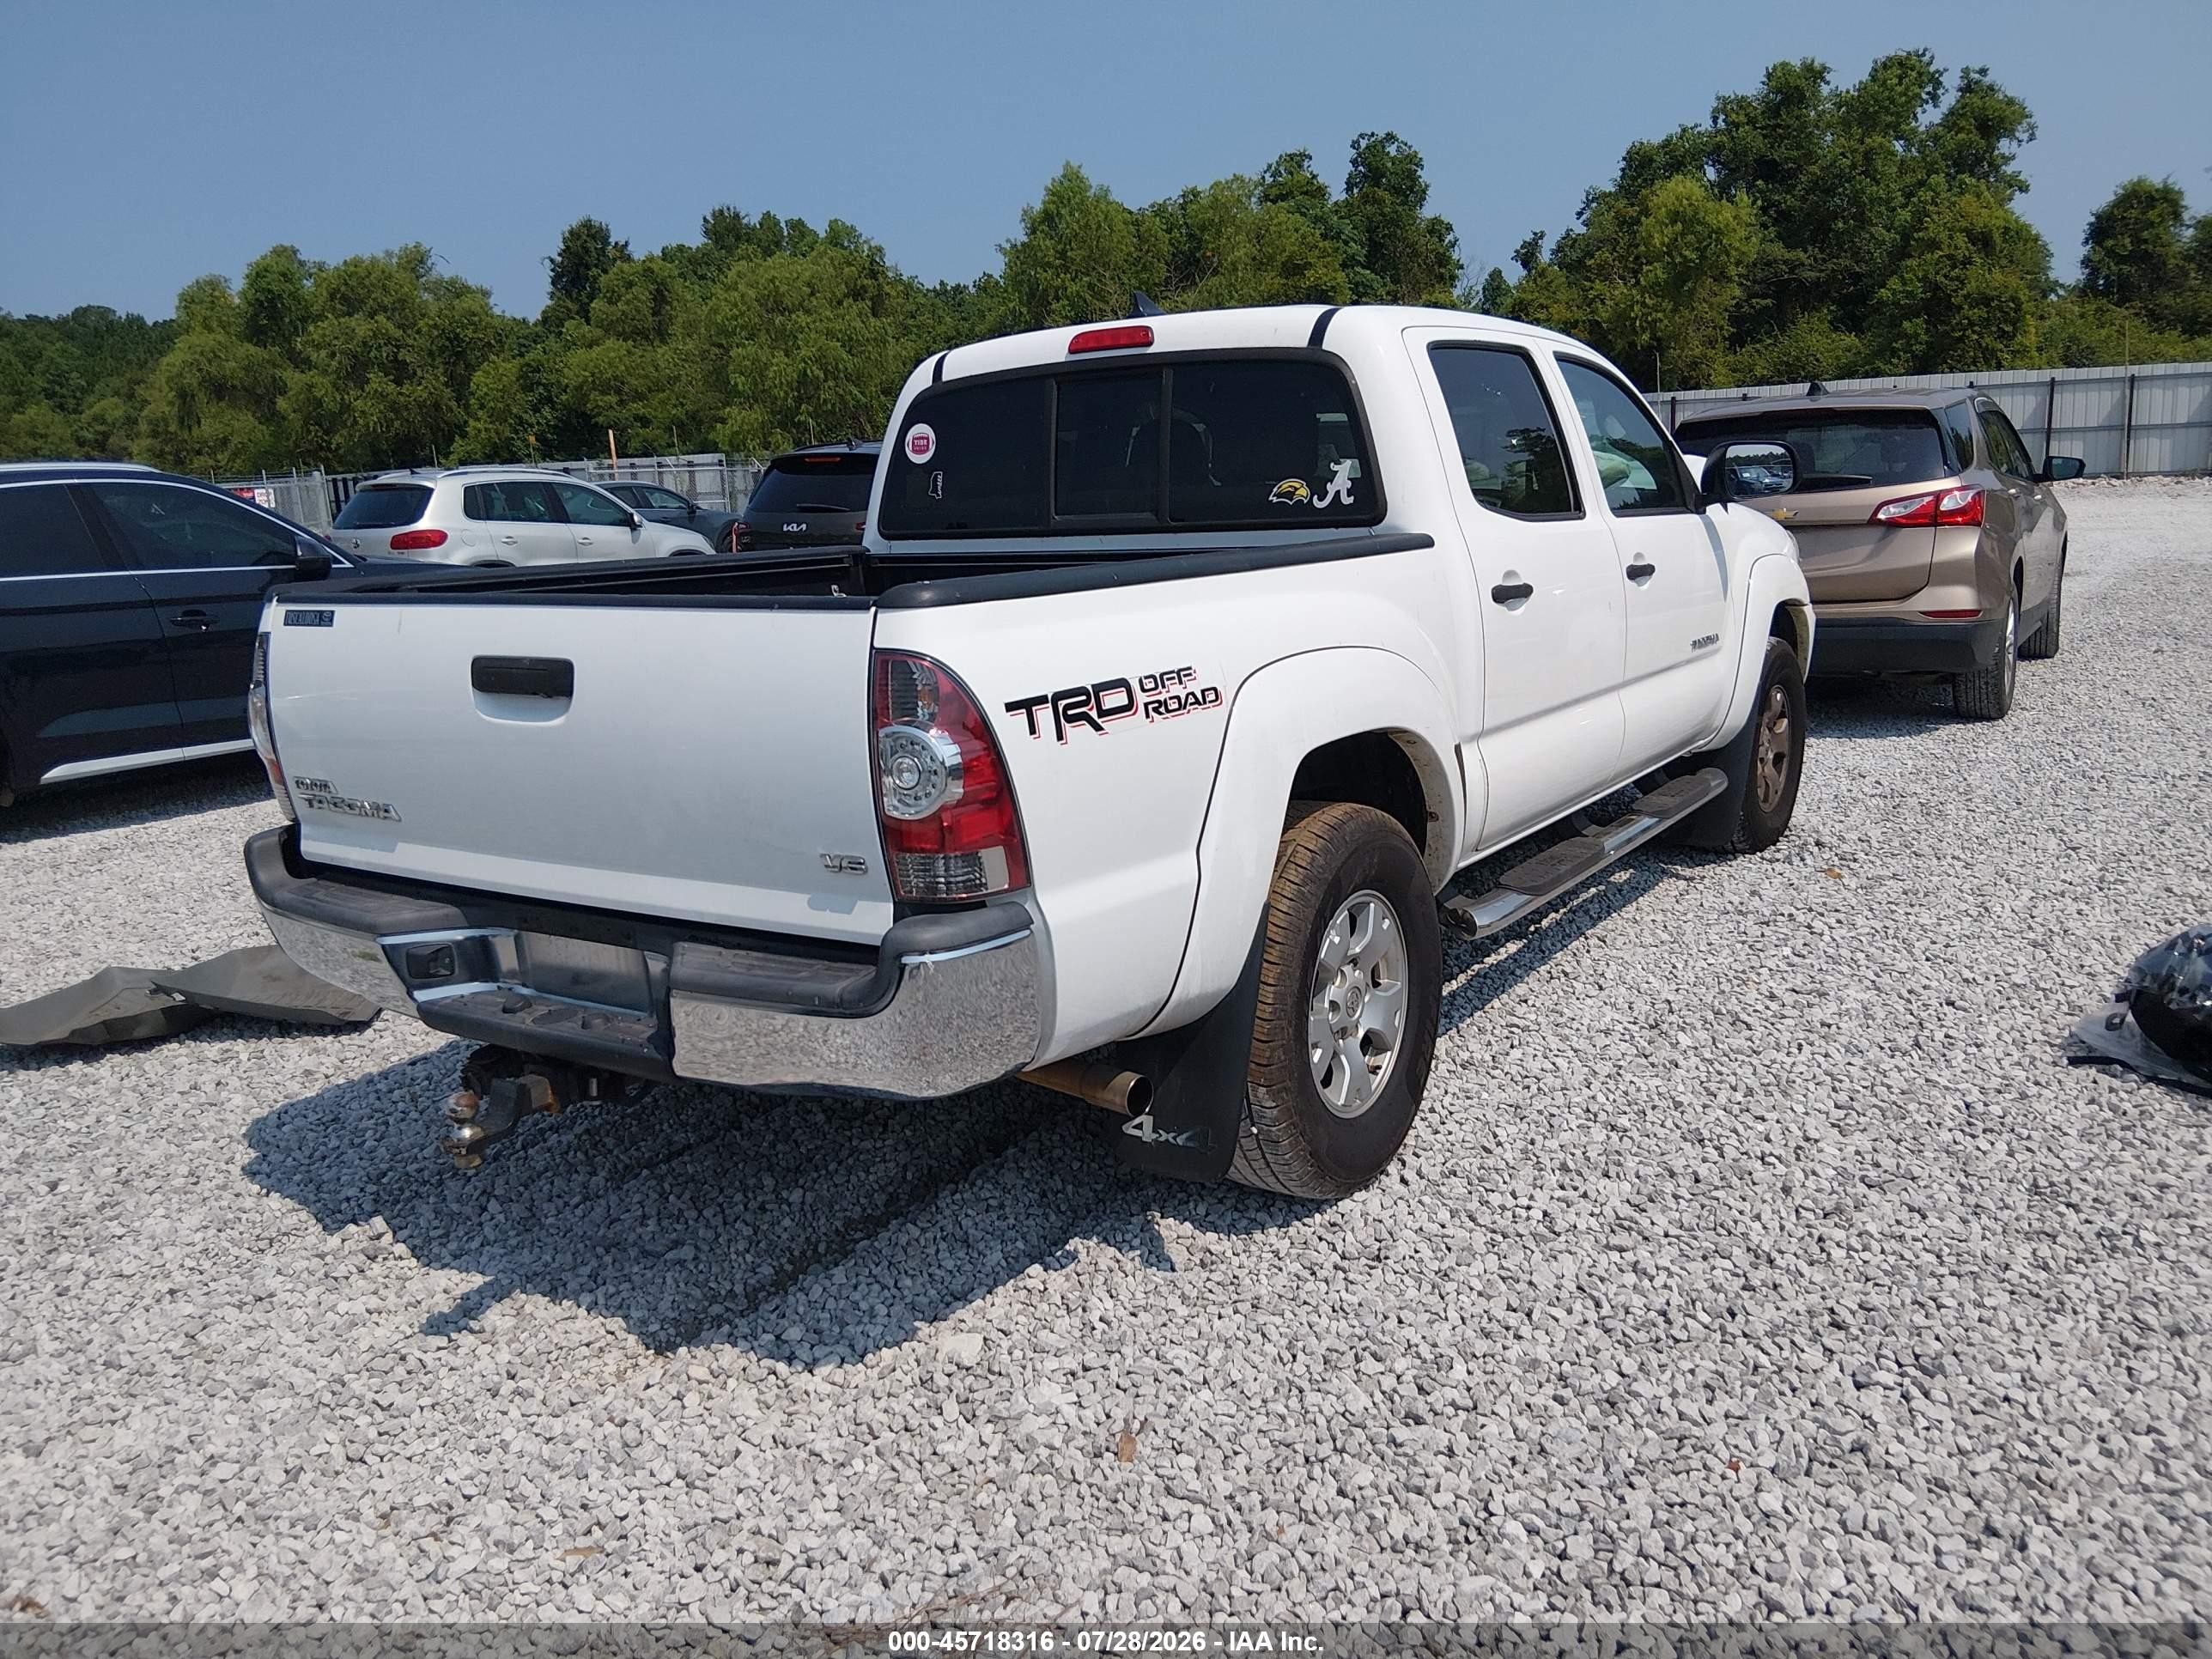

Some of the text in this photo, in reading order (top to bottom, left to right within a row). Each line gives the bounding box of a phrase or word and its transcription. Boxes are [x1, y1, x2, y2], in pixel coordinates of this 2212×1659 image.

[1313, 459, 1354, 508] A
[782, 523, 807, 532] KIA
[1138, 665, 1197, 696] OFF
[1004, 678, 1139, 745] TRD
[1143, 686, 1223, 723] ROAD
[297, 793, 402, 822] TACOMA
